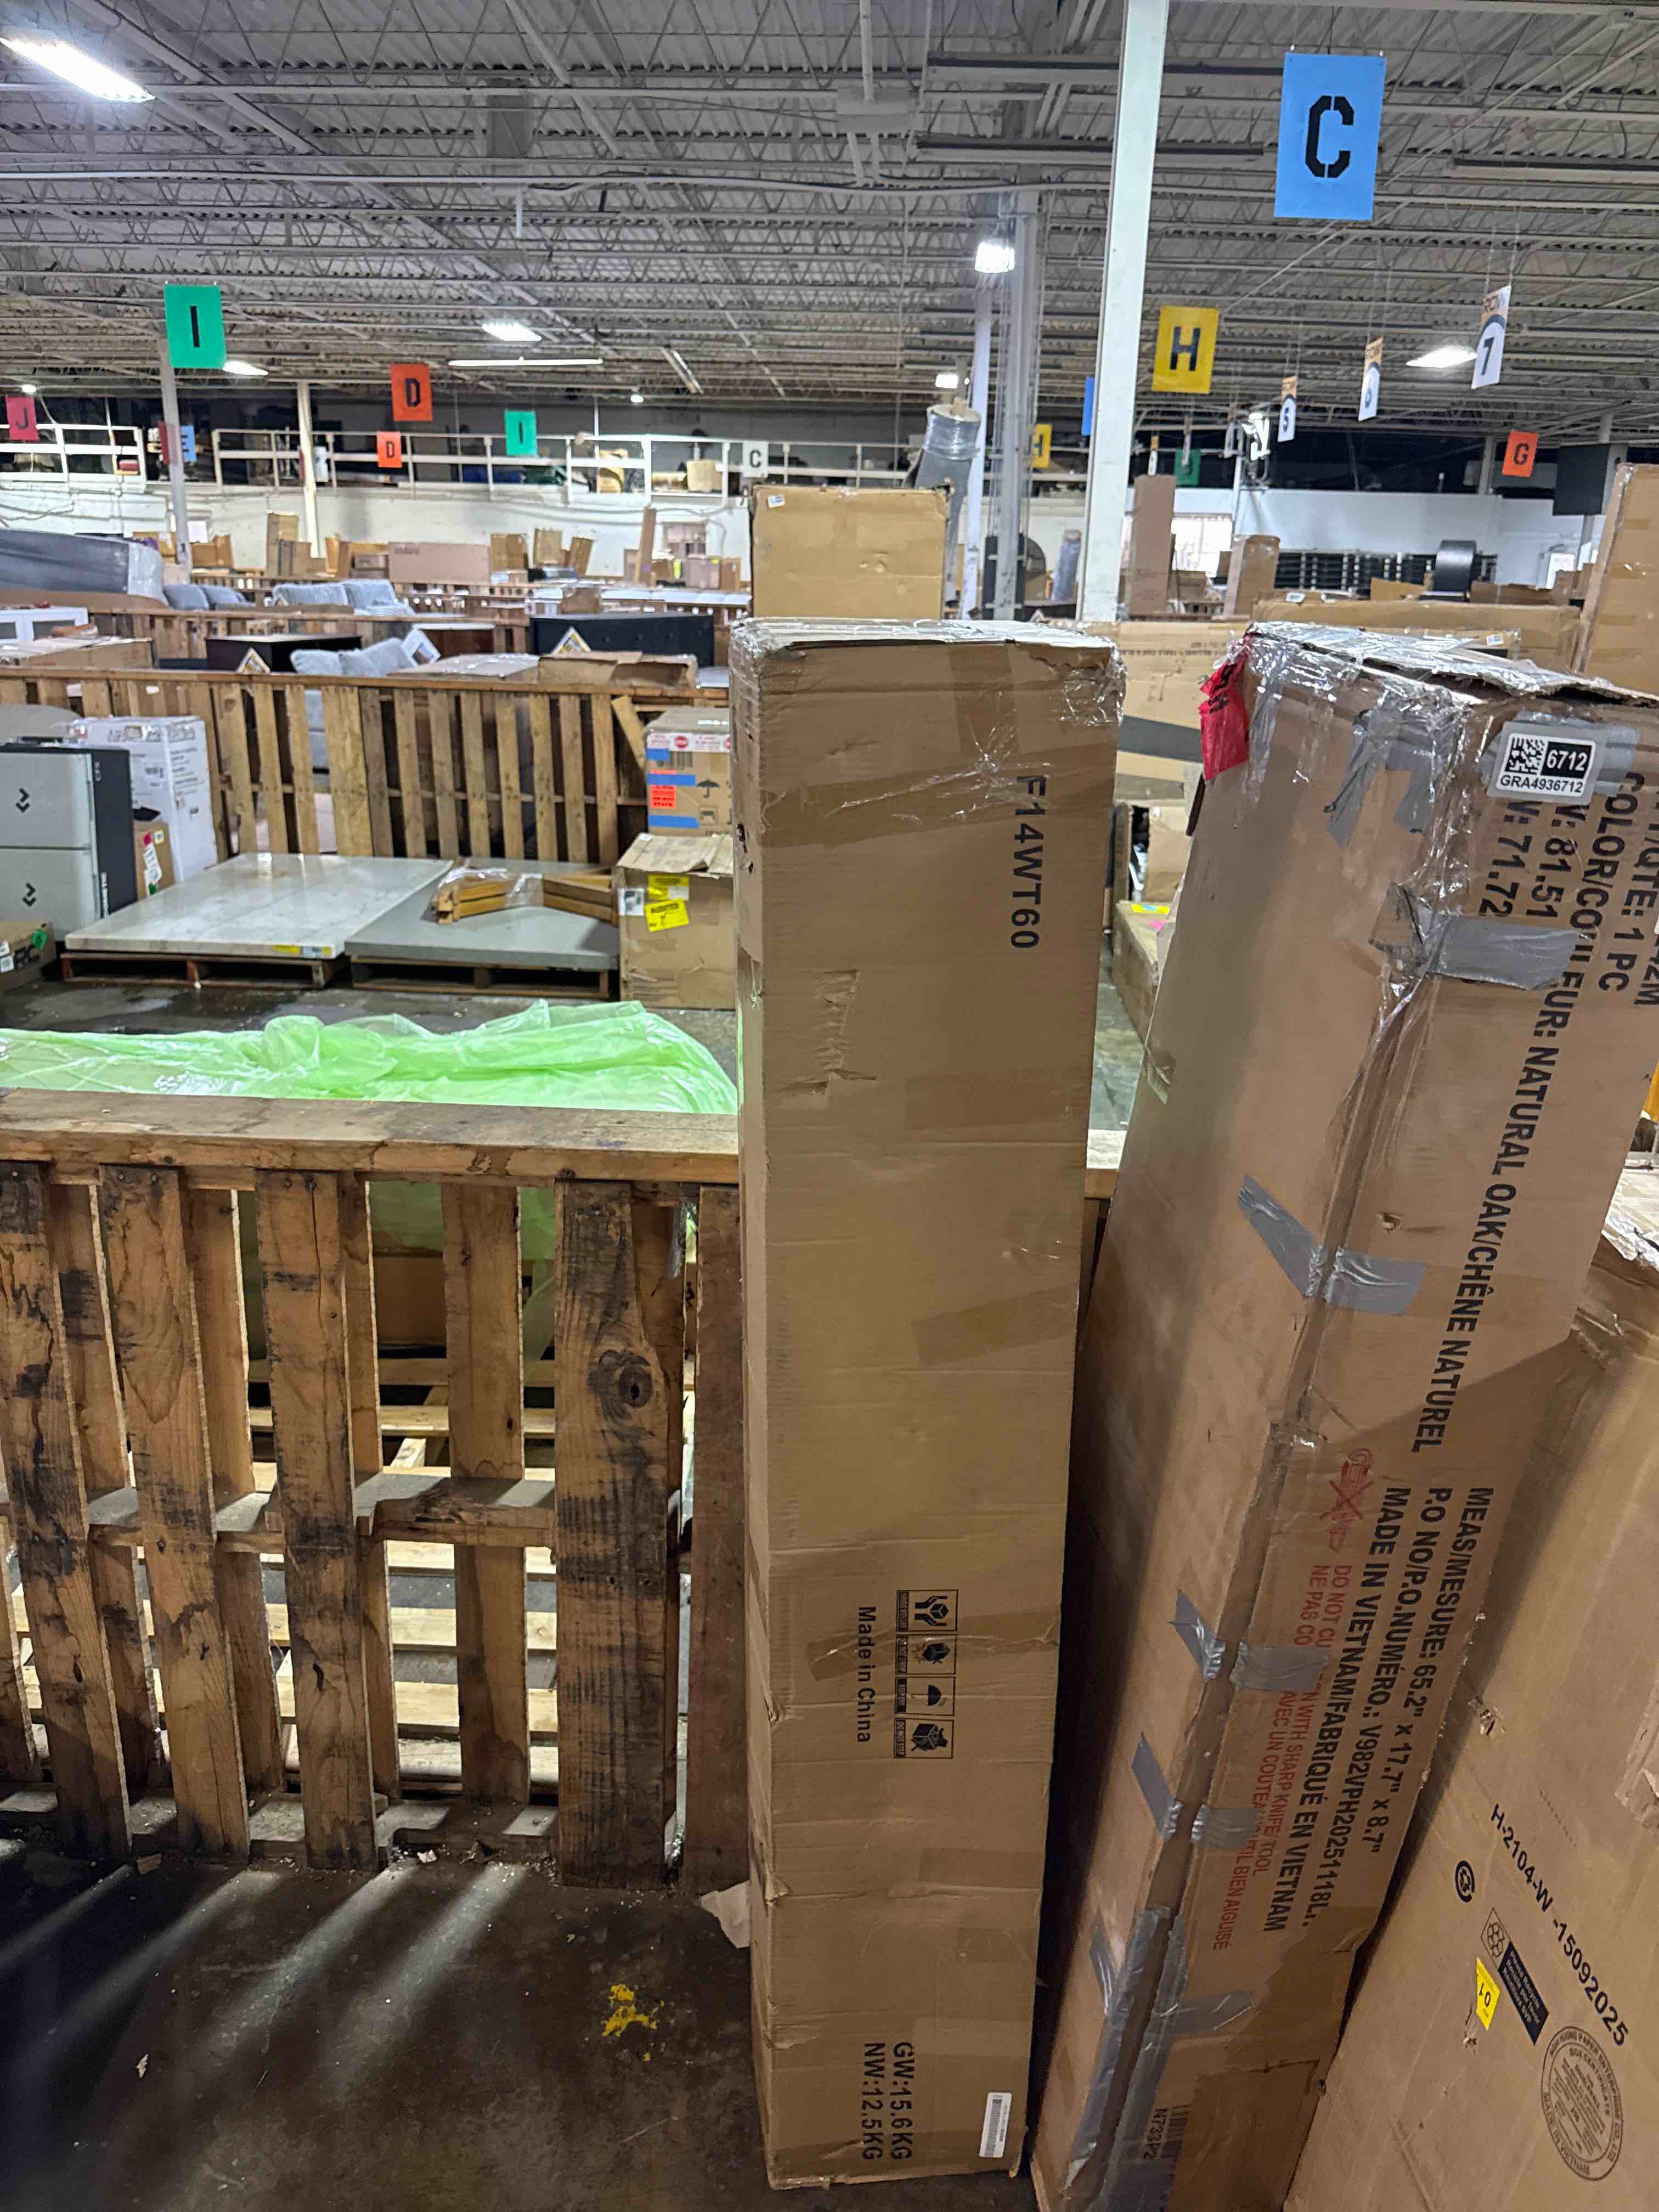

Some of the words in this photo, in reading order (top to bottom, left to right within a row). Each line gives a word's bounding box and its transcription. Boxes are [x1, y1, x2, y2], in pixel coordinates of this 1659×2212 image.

[1305, 95, 1355, 178] C
[190, 306, 200, 348] I
[1169, 326, 1201, 371] H
[405, 377, 421, 408] D
[16, 408, 29, 430] J
[518, 421, 524, 444] I
[386, 441, 395, 458] D
[749, 449, 762, 468] C
[1513, 443, 1528, 466] G
[1546, 749, 1588, 771] 6712
[1500, 774, 1583, 793] GRA4936712
[1011, 775, 1047, 949] F14WT60
[1478, 835, 1532, 918] 71.72
[1526, 837, 1578, 918] 81.51
[1613, 927, 1645, 941] 1
[1598, 952, 1638, 991] PC
[1492, 1046, 1560, 1176] NATURAL
[1445, 1183, 1517, 1333] OAK/CHÊNE
[1411, 1340, 1472, 1453] NATUREL
[1369, 1487, 1412, 1556] MADE
[1420, 1487, 1453, 1523] P.O
[1309, 1565, 1330, 1587] NE
[1331, 1565, 1352, 1589] DO
[1360, 1563, 1390, 1588] IN
[1419, 1487, 1494, 1658] MEAS/MESURE:
[1300, 1591, 1324, 1620] PAS
[1322, 1593, 1345, 1624] NOT
[857, 1606, 877, 1660] Made
[1317, 1628, 1336, 1647] CU
[857, 1664, 877, 1683] in
[1403, 1664, 1437, 1718] 65.2"
[856, 1686, 876, 1743] China
[1272, 1691, 1298, 1728] AVEC
[1299, 1594, 1382, 1806] VIETNAM/FABRIQUÉ
[1266, 1731, 1285, 1751] UN
[1290, 1705, 1315, 1741] WITH
[1394, 1723, 1414, 1737] x
[1276, 1743, 1304, 1791] SHARP
[1380, 1743, 1413, 1792] 17.7"
[1370, 1799, 1390, 1810] x
[1289, 1812, 1319, 1839] EN
[1363, 1815, 1390, 1853] 8.7"
[1252, 1839, 1277, 1876] TOOL
[1228, 1865, 1250, 1899] BIEN
[1262, 1843, 1310, 1932] VIETNAM
[1212, 1899, 1242, 1951] AIGUISÉ
[1491, 1803, 1554, 1913] H-2104-W
[1553, 1918, 1629, 2046] -15092025
